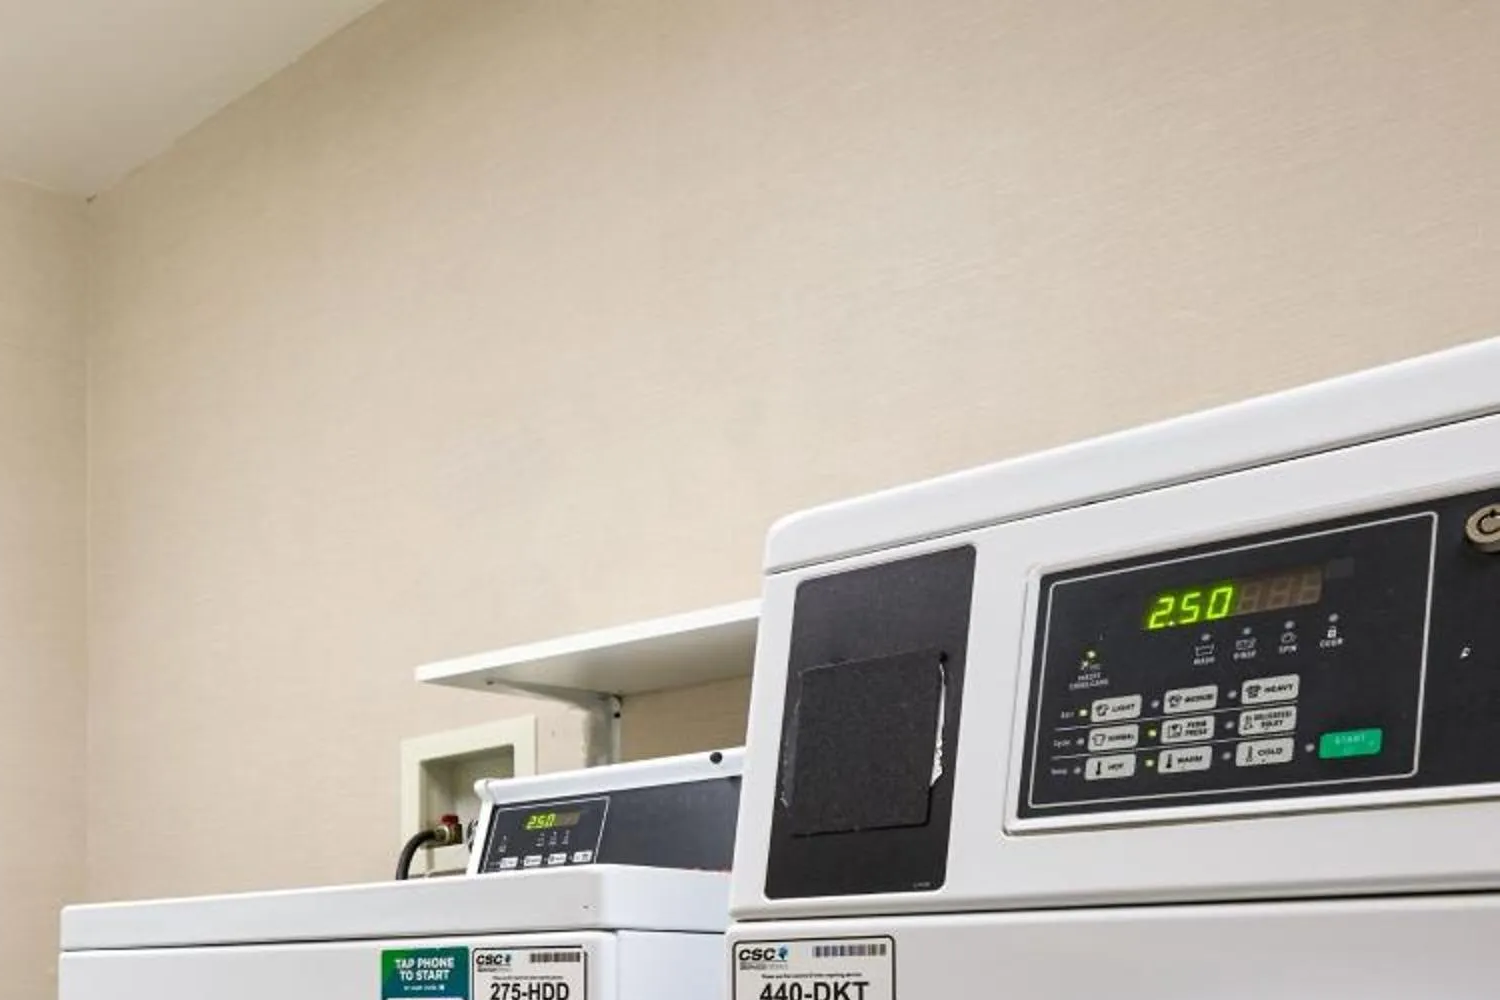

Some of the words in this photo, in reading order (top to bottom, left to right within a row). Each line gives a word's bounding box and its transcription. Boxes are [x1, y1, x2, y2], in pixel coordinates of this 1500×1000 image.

[1147, 586, 1234, 629] 2.50
[476, 953, 503, 965] CSC
[739, 948, 777, 961] CSC
[395, 958, 414, 969] TAP
[417, 957, 455, 969] PHONE
[400, 970, 414, 981] TO
[415, 969, 450, 981] START
[490, 982, 569, 1000] 275-HDD
